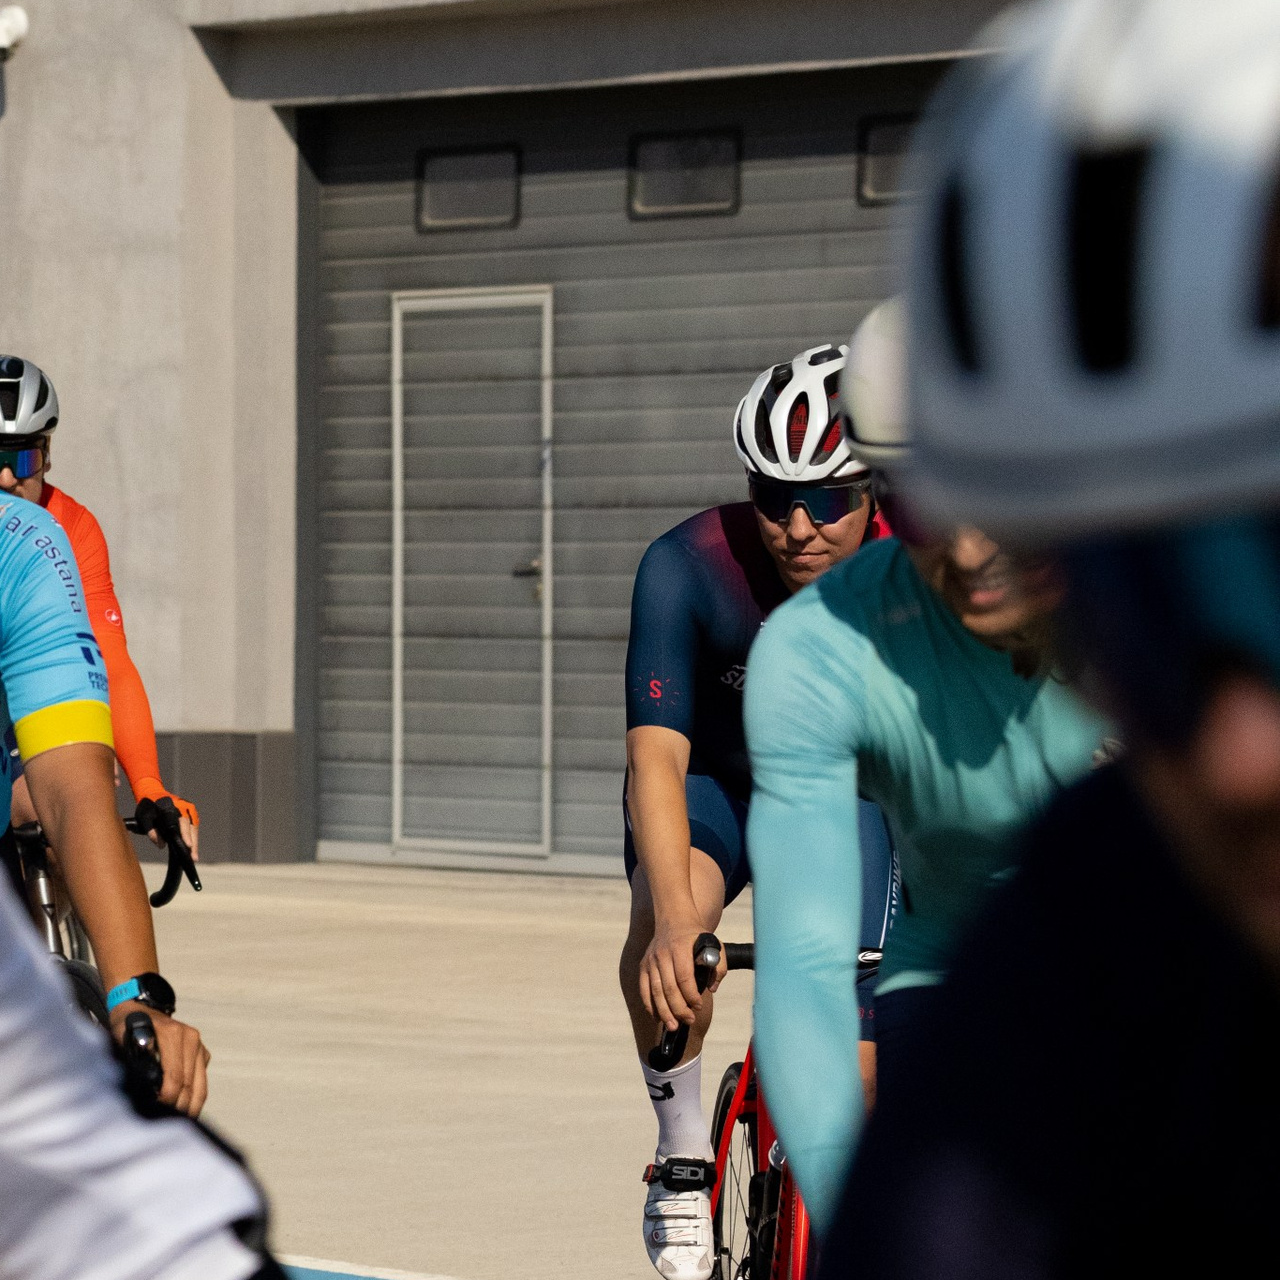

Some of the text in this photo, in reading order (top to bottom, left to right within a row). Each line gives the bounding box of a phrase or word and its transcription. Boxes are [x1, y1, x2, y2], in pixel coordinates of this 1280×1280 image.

[5, 515, 81, 613] ar astana
[649, 679, 662, 699] S
[671, 1165, 705, 1181] SIDI
